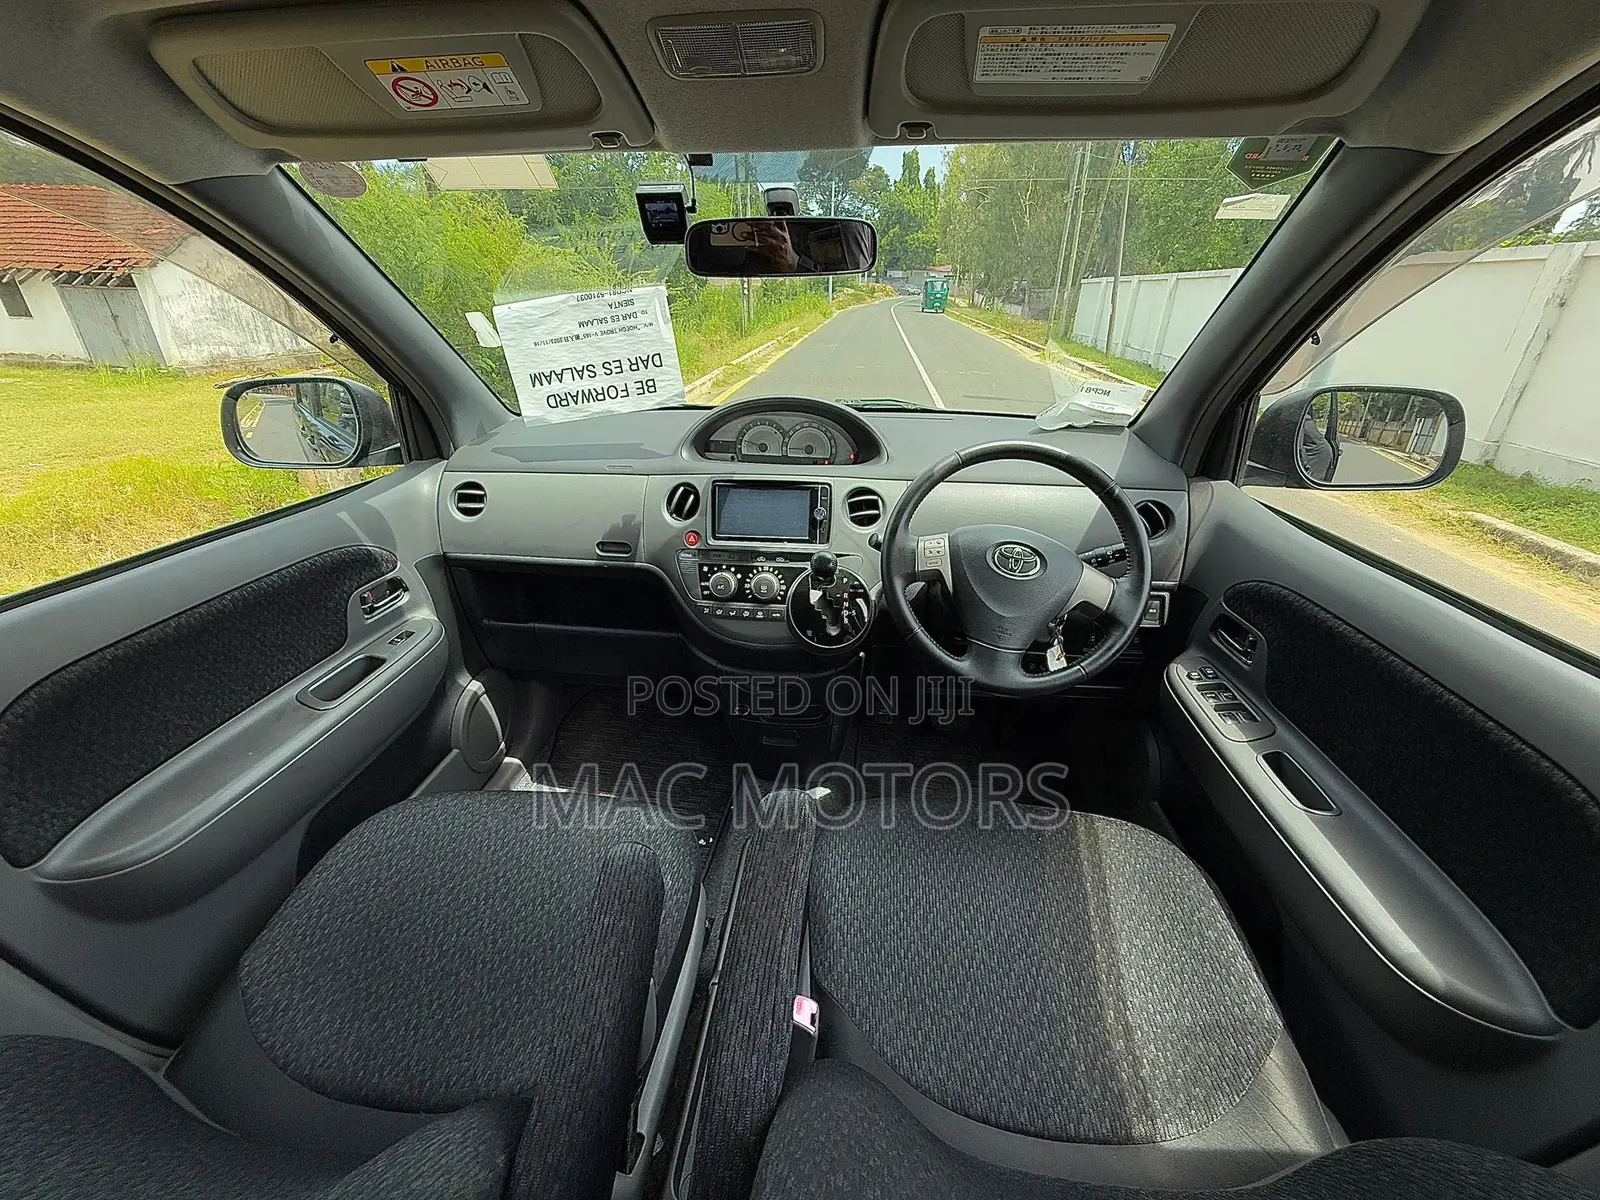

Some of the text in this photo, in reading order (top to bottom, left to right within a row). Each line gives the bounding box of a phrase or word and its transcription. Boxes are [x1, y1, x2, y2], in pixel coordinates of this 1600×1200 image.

[424, 56, 485, 70] AIRBAG
[607, 298, 635, 310] SIENTA
[577, 316, 609, 328] SALAAM
[609, 314, 620, 323] ES
[621, 311, 638, 321] DAR
[529, 352, 664, 388] DAR ES SALAAM
[546, 378, 657, 409] BE FORWARD
